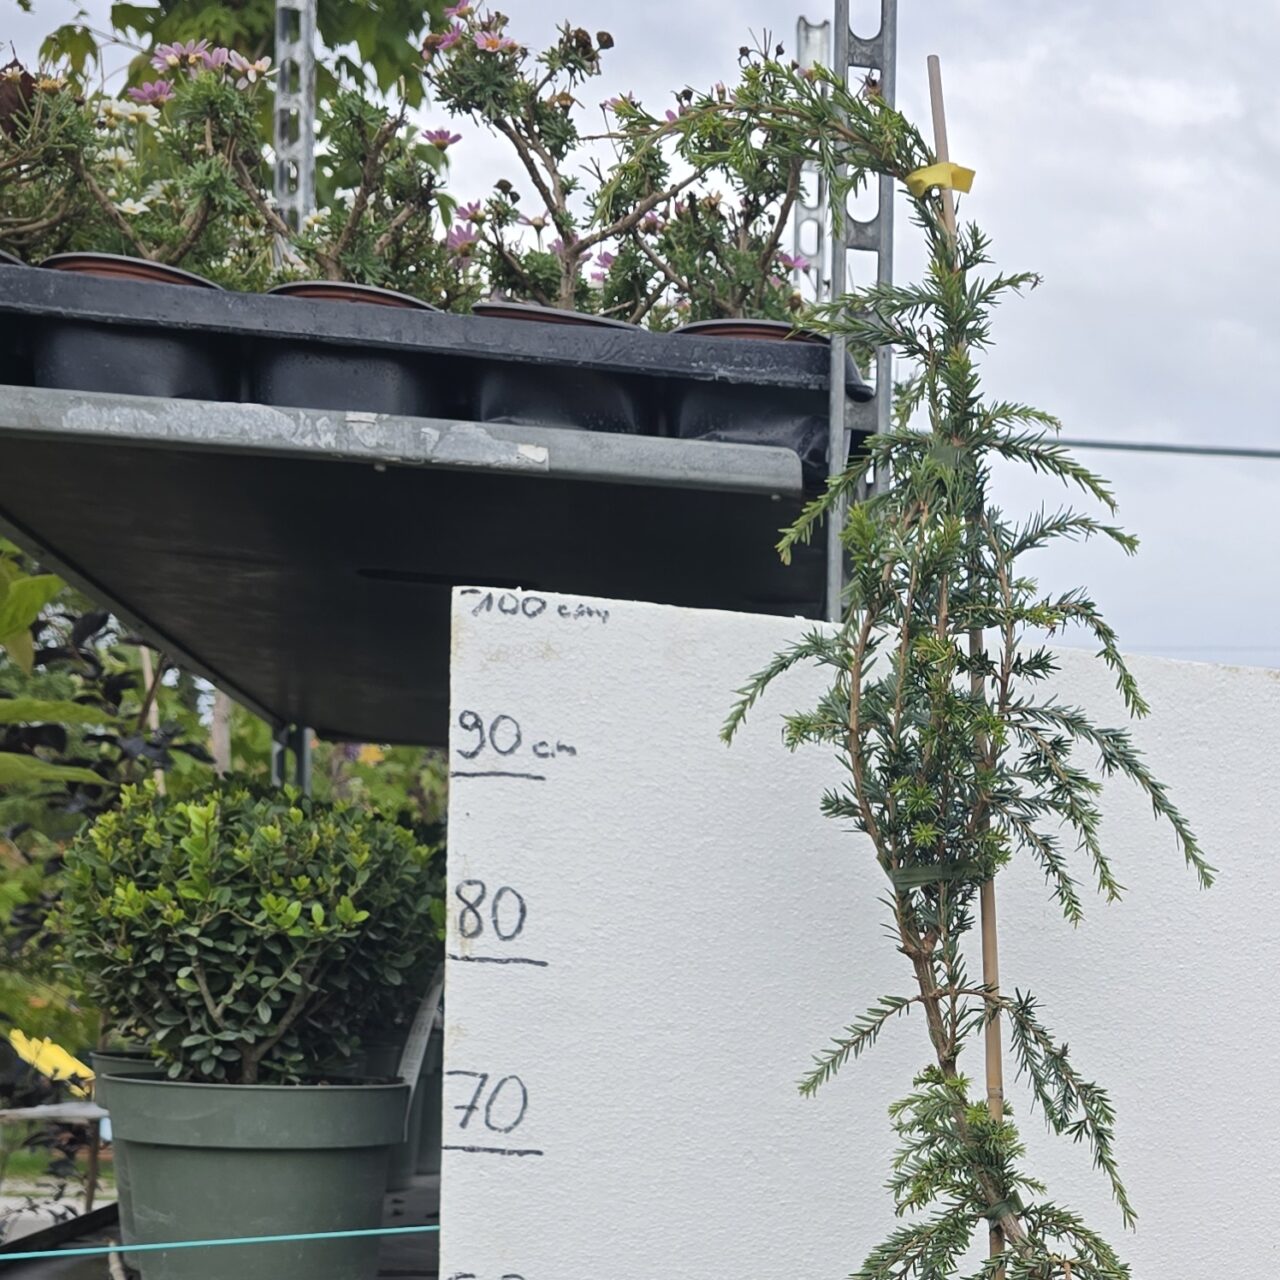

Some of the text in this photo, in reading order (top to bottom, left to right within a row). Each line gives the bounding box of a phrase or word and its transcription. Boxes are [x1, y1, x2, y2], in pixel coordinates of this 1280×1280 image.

[471, 592, 548, 619] 100
[456, 709, 578, 759] 90 cm
[455, 879, 527, 941] 80
[445, 1070, 529, 1133] 70
